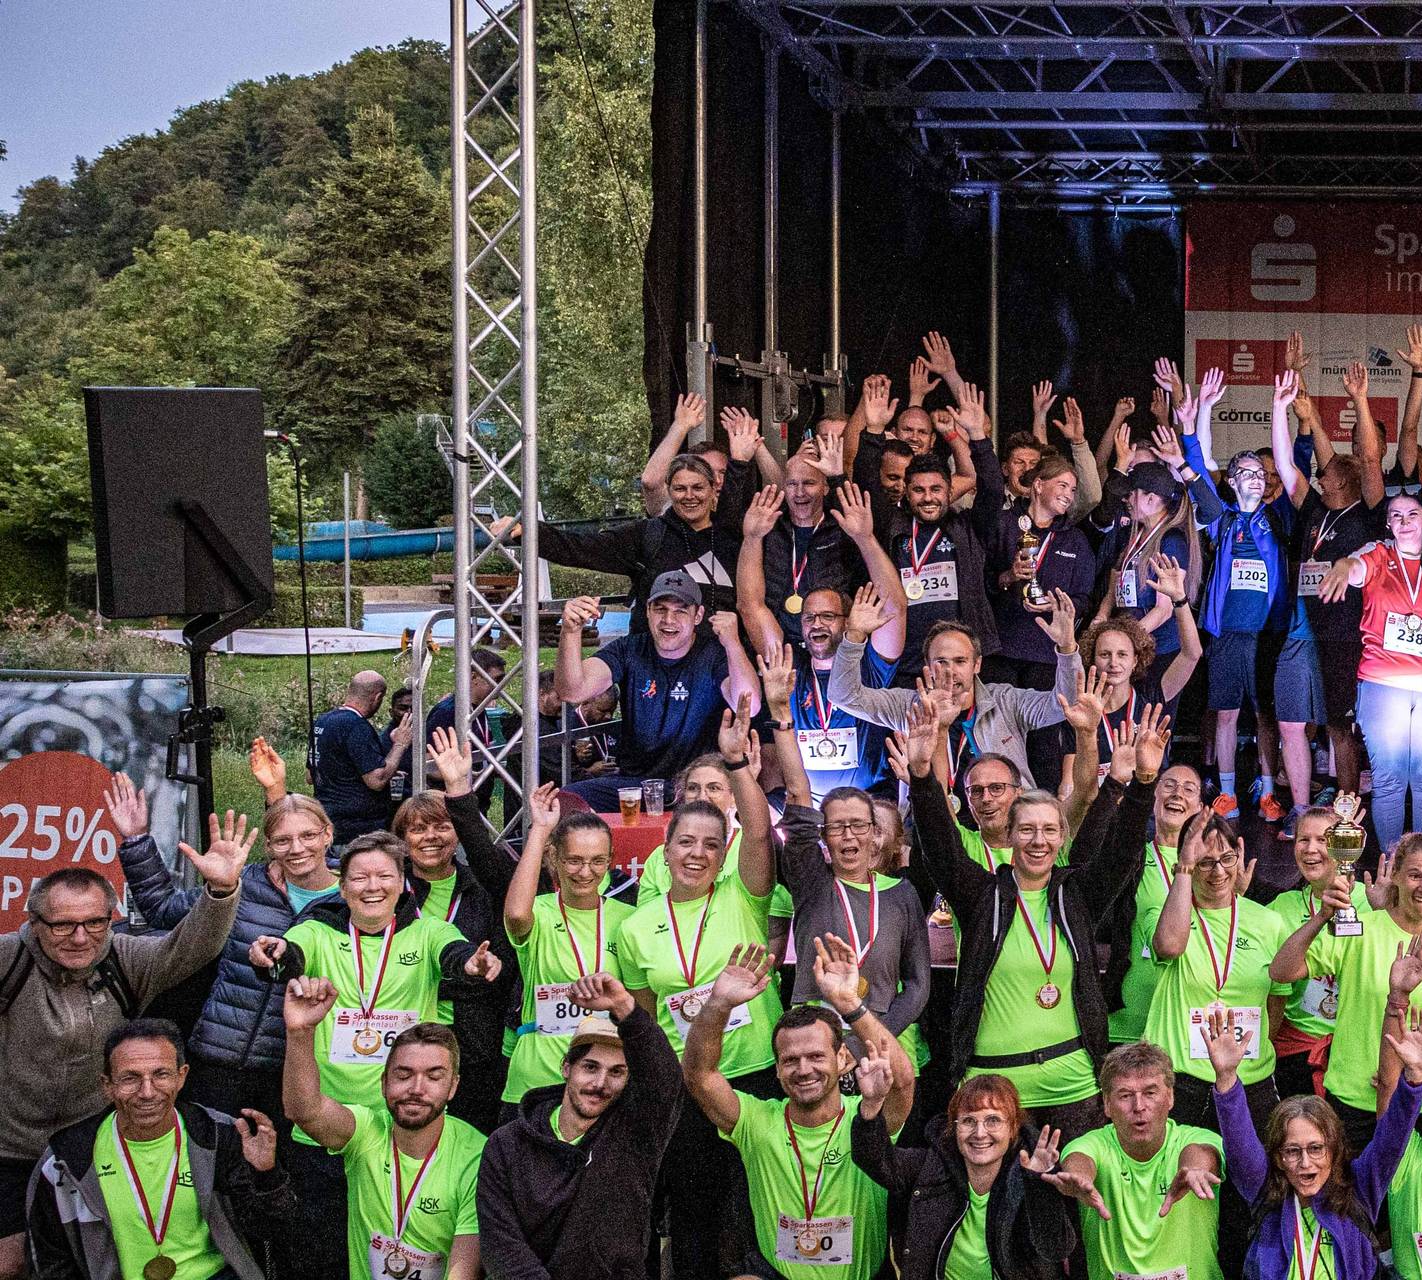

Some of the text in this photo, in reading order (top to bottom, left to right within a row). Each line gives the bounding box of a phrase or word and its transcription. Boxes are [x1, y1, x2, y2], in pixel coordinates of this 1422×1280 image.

[1218, 409, 1290, 422] GÖTTGE
[921, 576, 950, 591] 234
[1237, 571, 1267, 583] 1202
[808, 744, 848, 758] 17
[0, 803, 117, 864] 25%
[399, 951, 420, 963] HSK
[823, 1148, 842, 1163] HSK
[420, 1197, 440, 1210] HSK
[790, 1220, 833, 1229] Sparkassen
